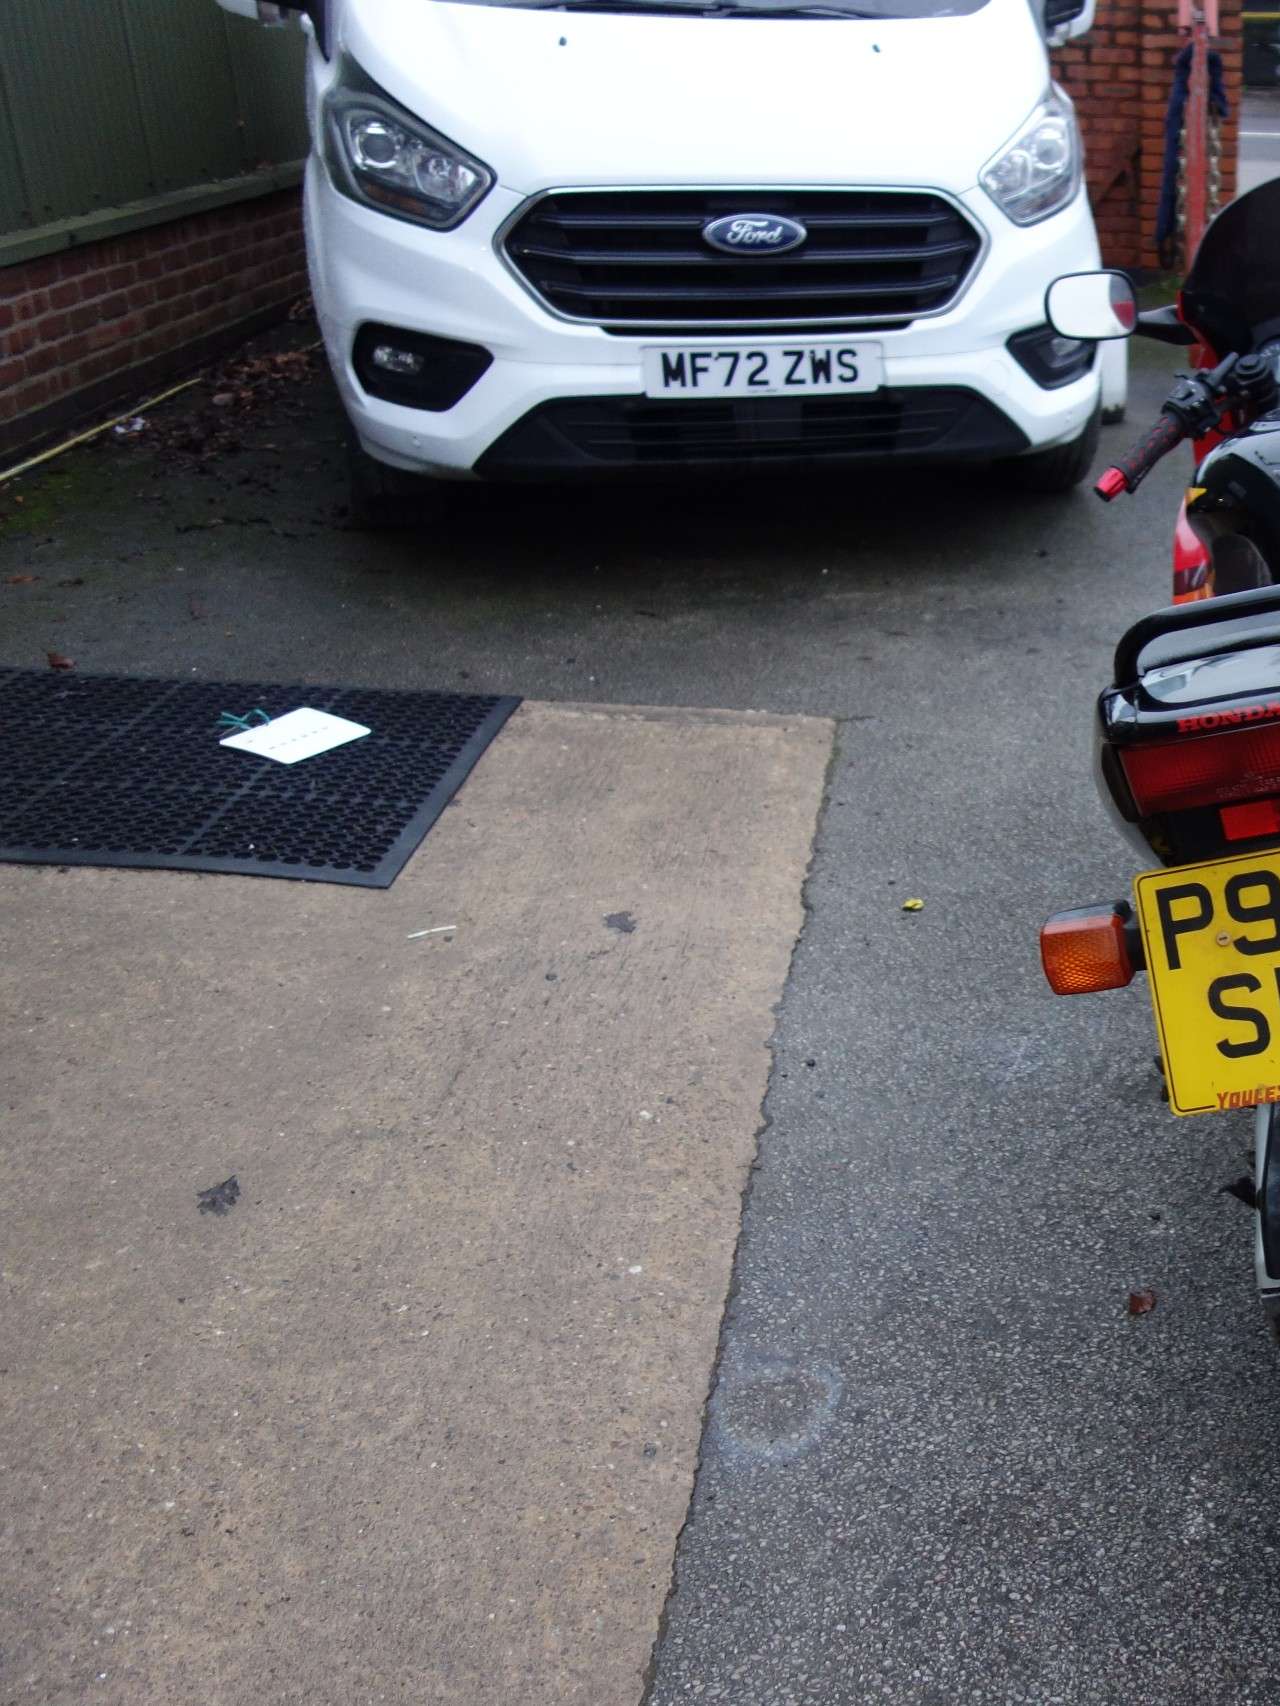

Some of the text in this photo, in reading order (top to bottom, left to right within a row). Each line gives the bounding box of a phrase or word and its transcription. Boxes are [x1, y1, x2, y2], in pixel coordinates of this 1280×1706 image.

[727, 219, 782, 244] Ford
[661, 349, 859, 388] MF72 ZWS
